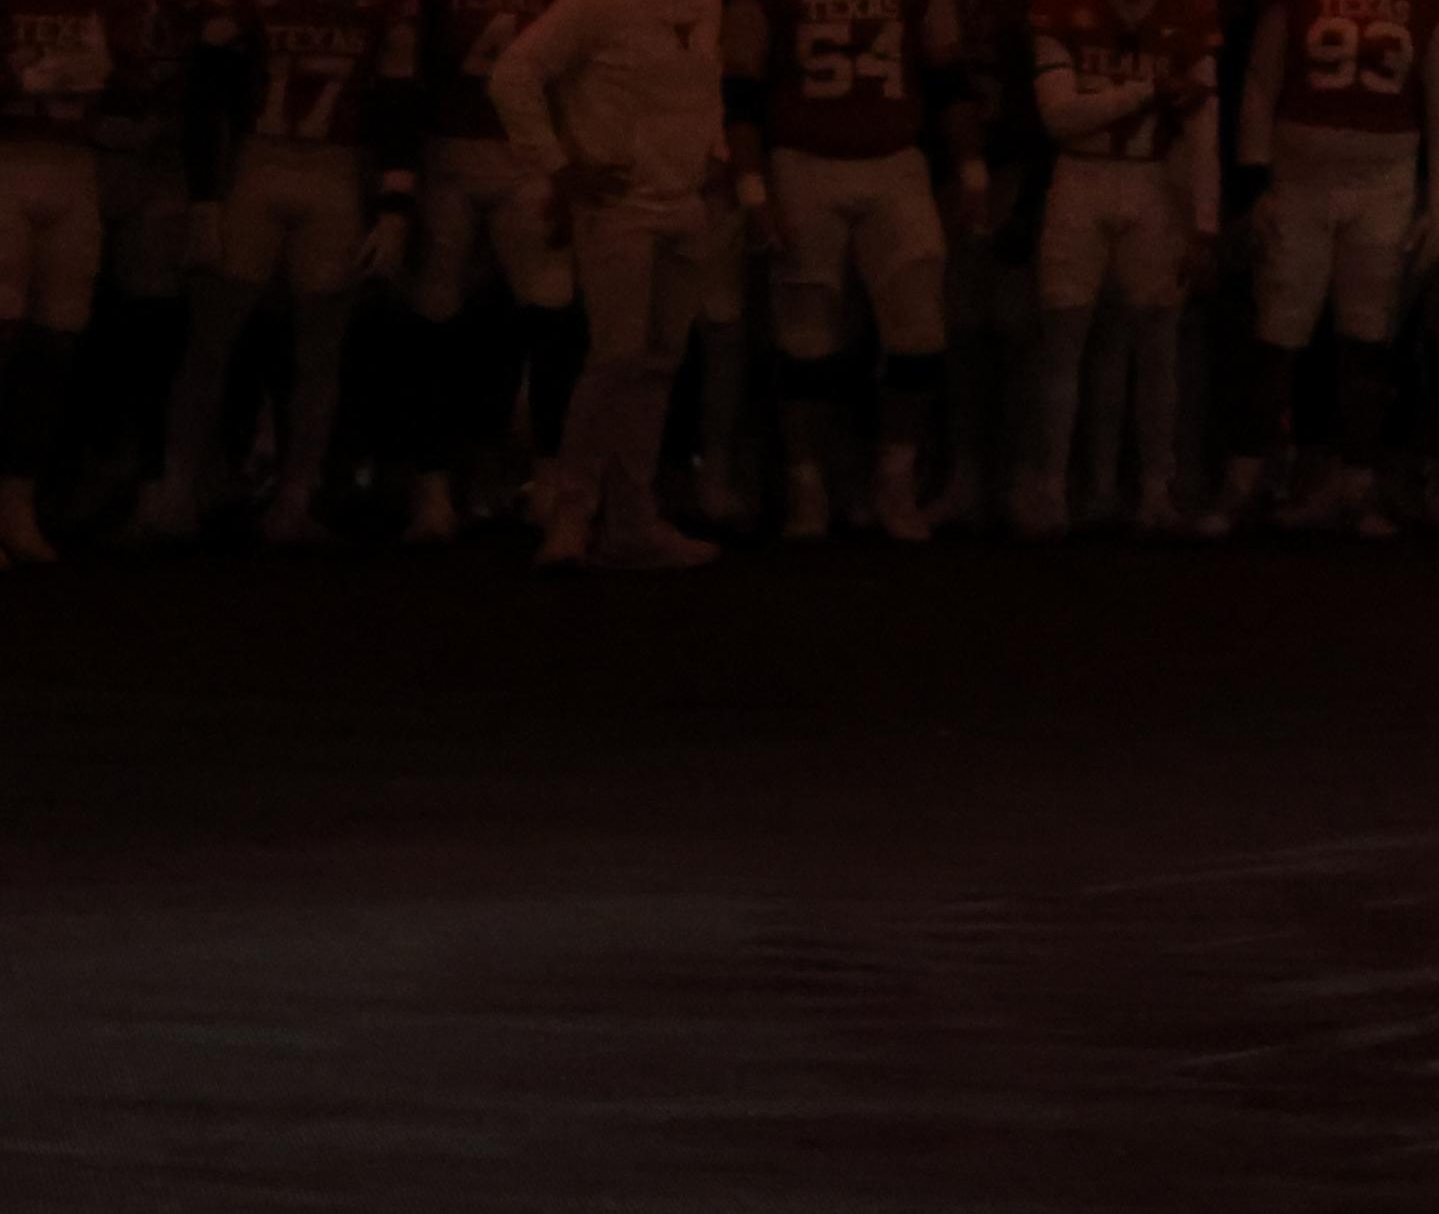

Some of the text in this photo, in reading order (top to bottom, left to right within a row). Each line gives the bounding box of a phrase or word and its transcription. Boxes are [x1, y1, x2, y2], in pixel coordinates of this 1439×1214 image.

[265, 24, 366, 54] TEXAS
[797, 21, 906, 99] 54
[1307, 18, 1414, 95] 93
[256, 56, 355, 138] 17
